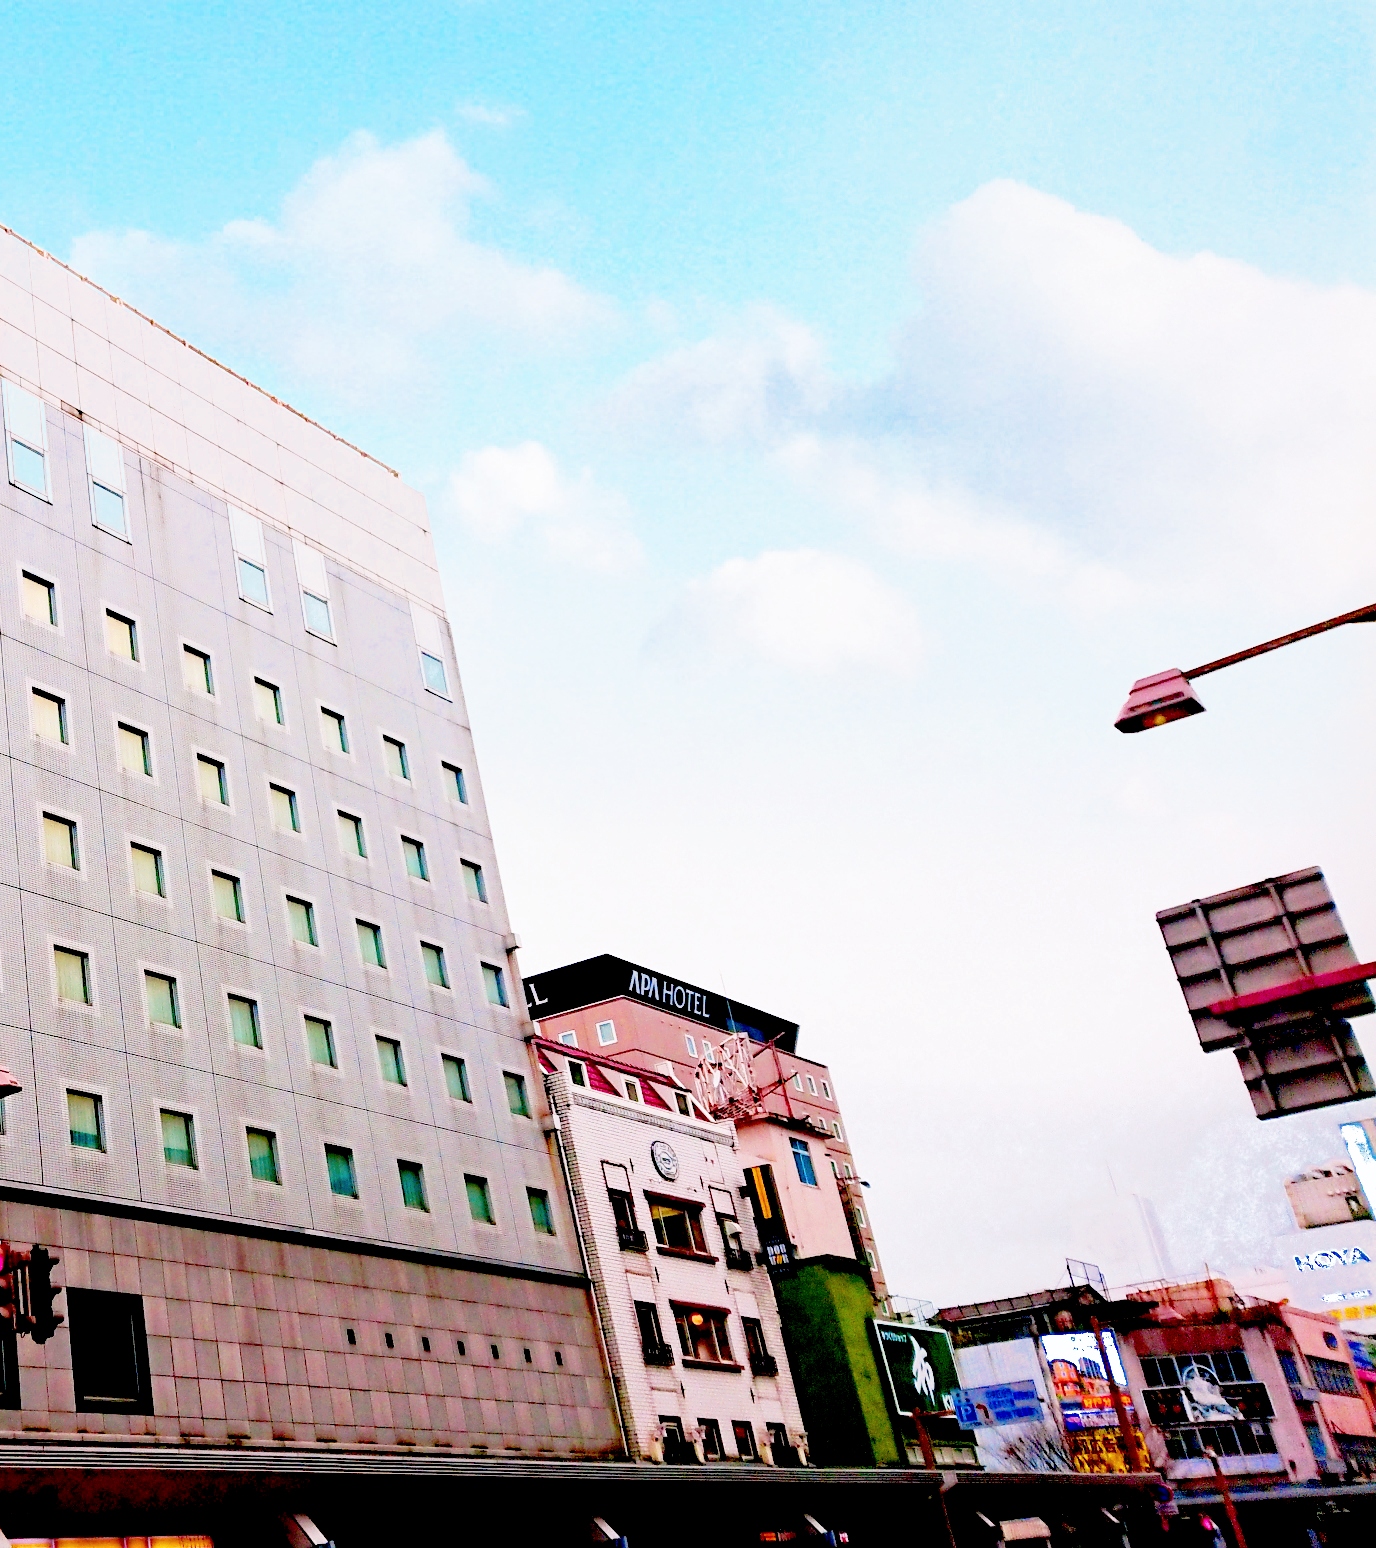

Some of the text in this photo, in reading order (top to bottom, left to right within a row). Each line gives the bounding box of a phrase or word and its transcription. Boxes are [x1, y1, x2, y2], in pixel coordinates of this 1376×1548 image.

[628, 969, 710, 1018] APA HOTEL
[1294, 1246, 1372, 1272] HOYA
